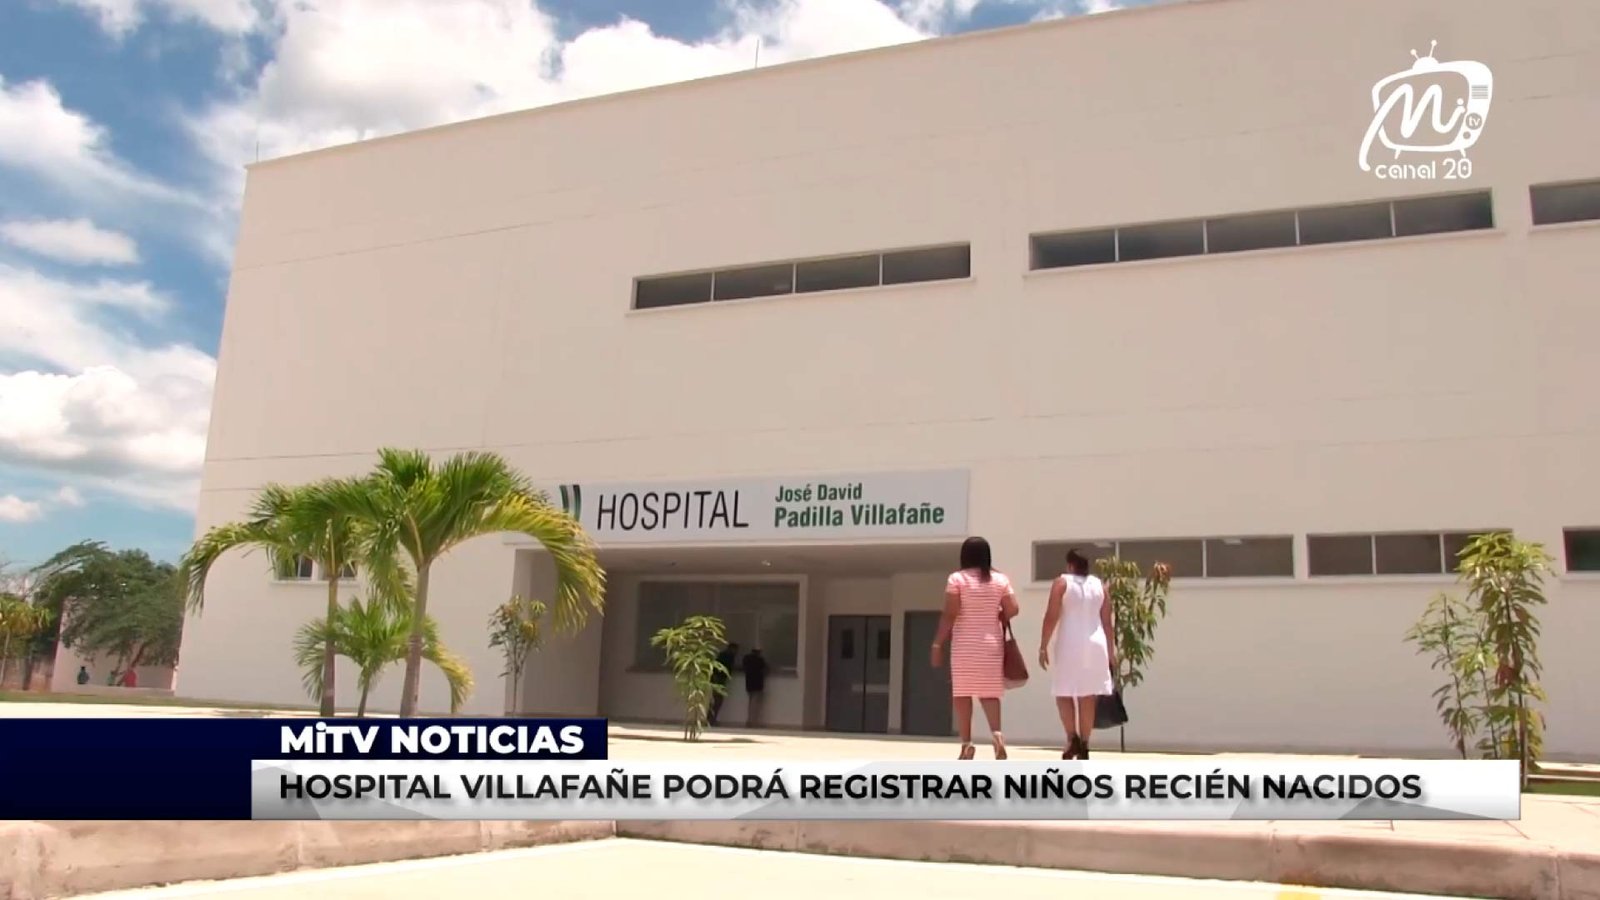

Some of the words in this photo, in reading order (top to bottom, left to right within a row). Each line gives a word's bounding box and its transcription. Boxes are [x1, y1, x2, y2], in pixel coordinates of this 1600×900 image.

[775, 485, 812, 503] José
[817, 483, 863, 501] David
[597, 490, 750, 531] HOSPITAL
[774, 506, 844, 528] Padilla
[850, 502, 945, 526] Villafañe
